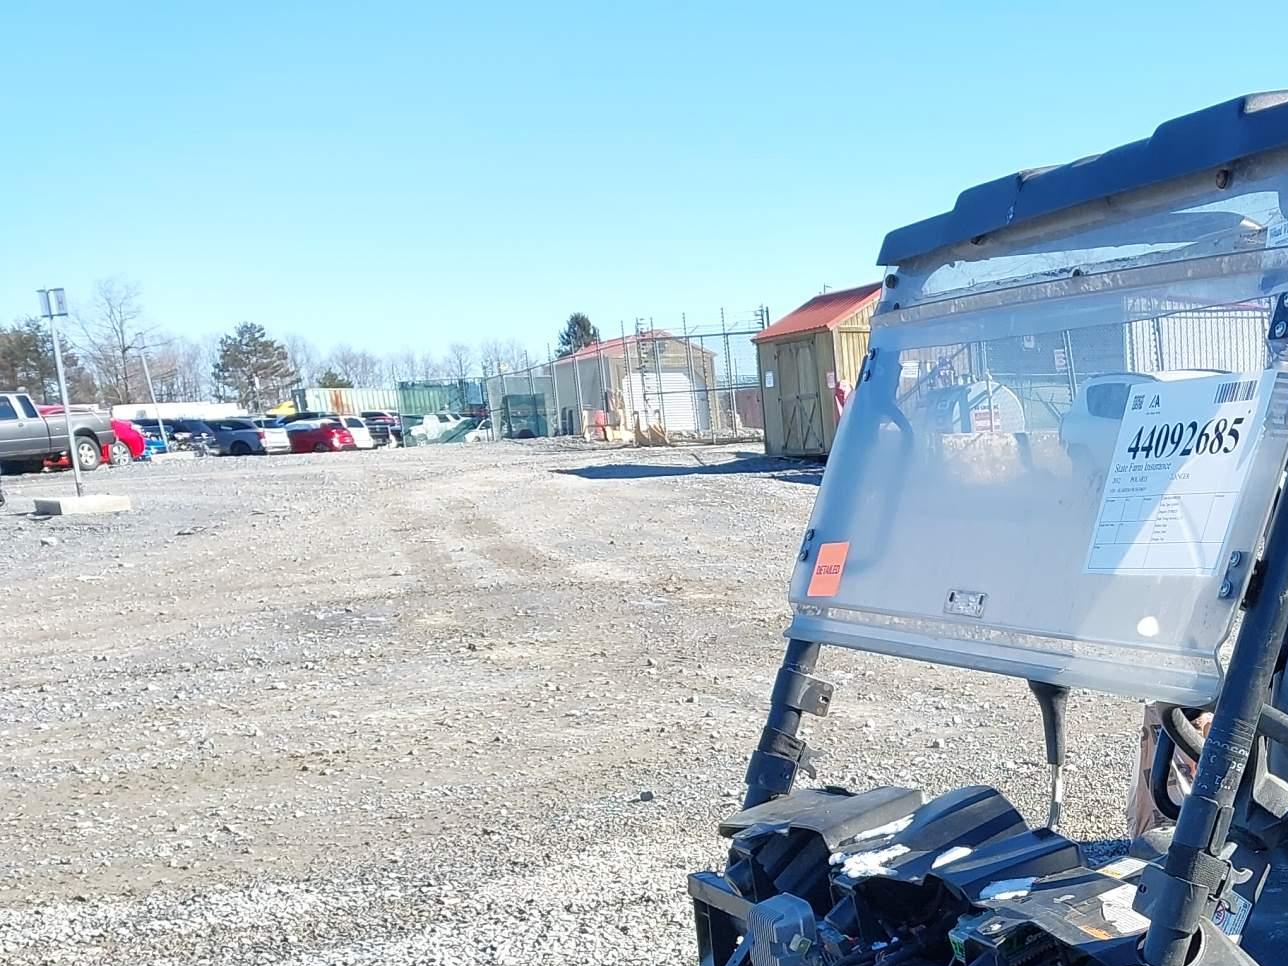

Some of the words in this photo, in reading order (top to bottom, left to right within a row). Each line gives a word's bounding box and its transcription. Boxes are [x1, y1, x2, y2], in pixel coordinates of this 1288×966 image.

[1127, 417, 1244, 460] 44092685
[1114, 463, 1129, 473] State
[1129, 463, 1144, 472] Farm
[816, 564, 841, 576] DETAILED
